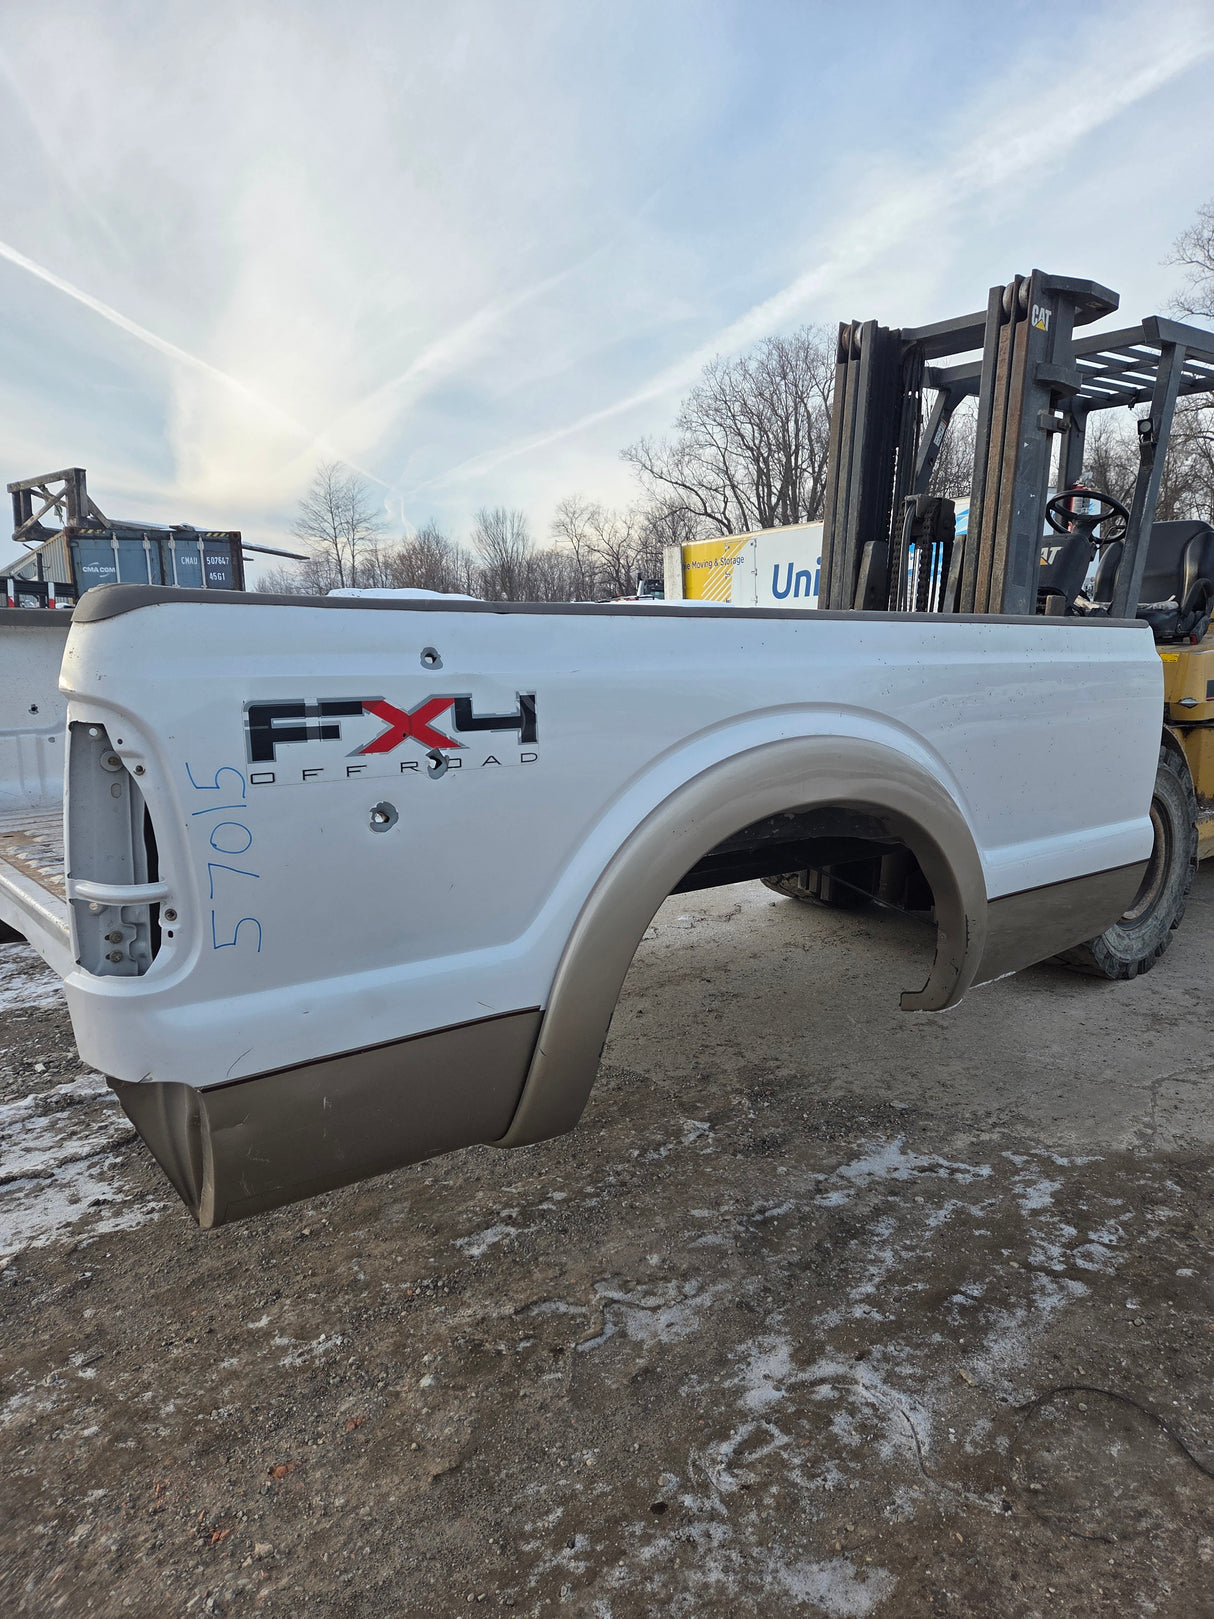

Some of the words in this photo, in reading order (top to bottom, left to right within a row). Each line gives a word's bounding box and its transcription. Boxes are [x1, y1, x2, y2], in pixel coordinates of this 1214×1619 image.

[1031, 304, 1052, 332] CAT
[691, 559, 713, 569] Moving
[714, 557, 719, 567] &
[720, 556, 745, 566] Storage
[1040, 546, 1064, 565] AT
[209, 572, 226, 581] 45G1
[243, 691, 538, 764] FX4
[250, 765, 367, 785] OFF
[185, 761, 263, 953] 57015
